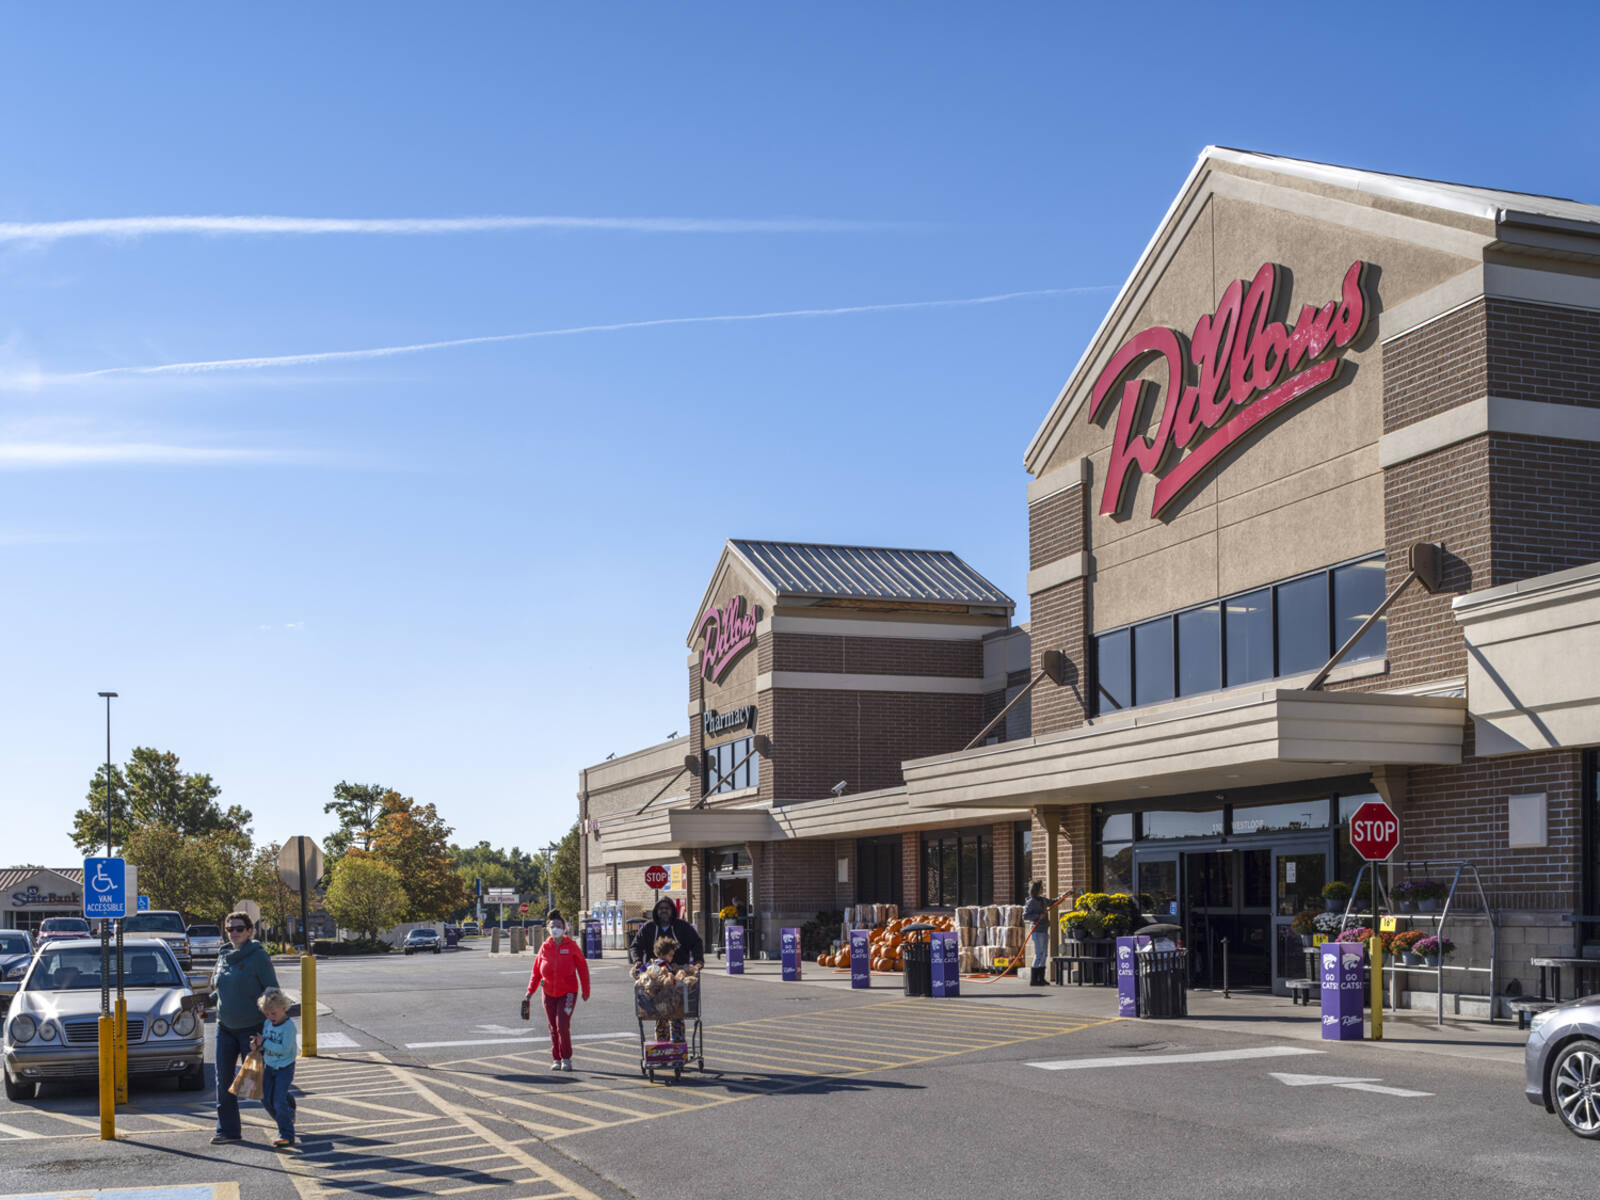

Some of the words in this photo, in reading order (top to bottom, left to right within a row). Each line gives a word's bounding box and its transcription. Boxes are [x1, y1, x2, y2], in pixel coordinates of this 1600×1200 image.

[1089, 260, 1364, 516] Dillons
[700, 595, 756, 681] Dillons
[704, 705, 750, 734] Pharmacy
[1354, 821, 1396, 842] STOP
[646, 872, 667, 882] STOP
[98, 895, 112, 903] VAN
[87, 903, 124, 912] ACCESSIBLE
[1345, 973, 1357, 981] GO
[1321, 981, 1339, 990] CATS!
[1340, 981, 1362, 990] CATS!
